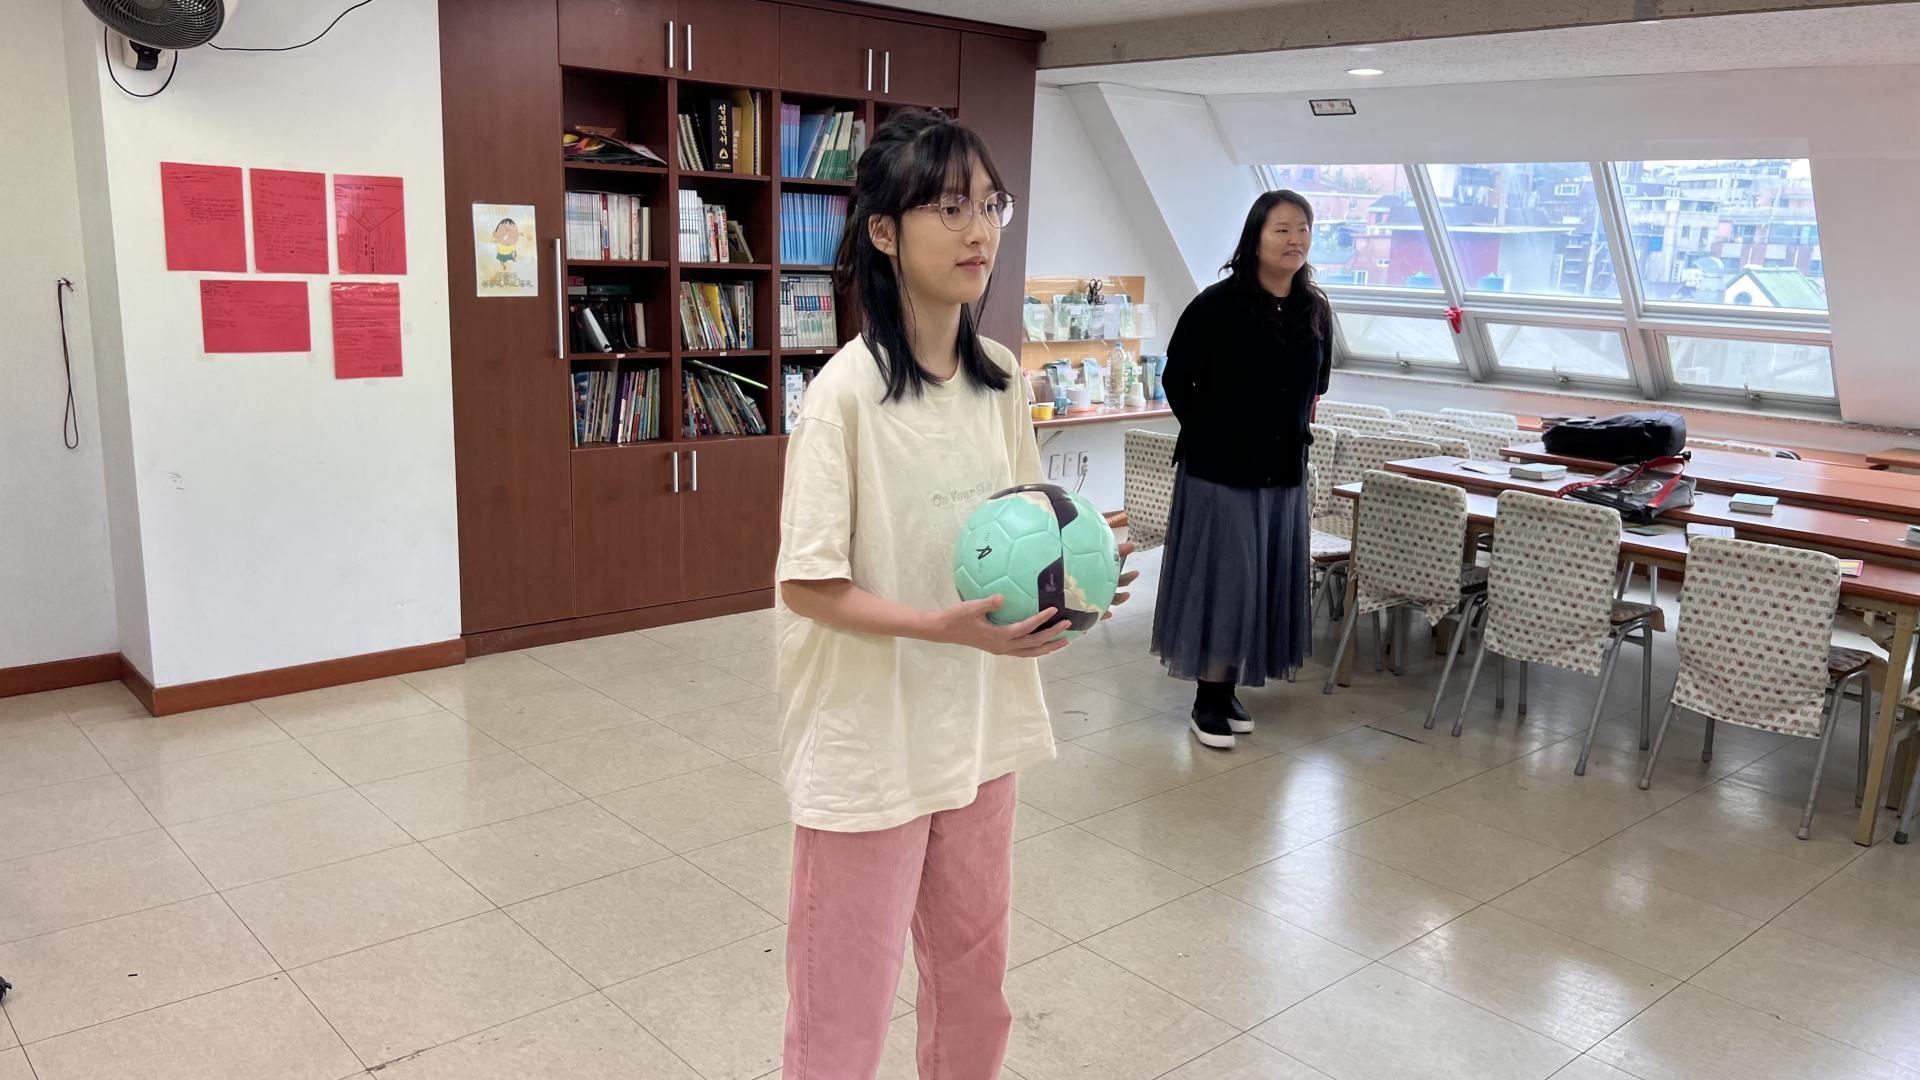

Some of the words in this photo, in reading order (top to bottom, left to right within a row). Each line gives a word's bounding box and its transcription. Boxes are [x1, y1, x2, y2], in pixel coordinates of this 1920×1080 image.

[718, 103, 728, 146] 성경전서
[932, 494, 949, 508] On
[950, 488, 975, 503] Your
